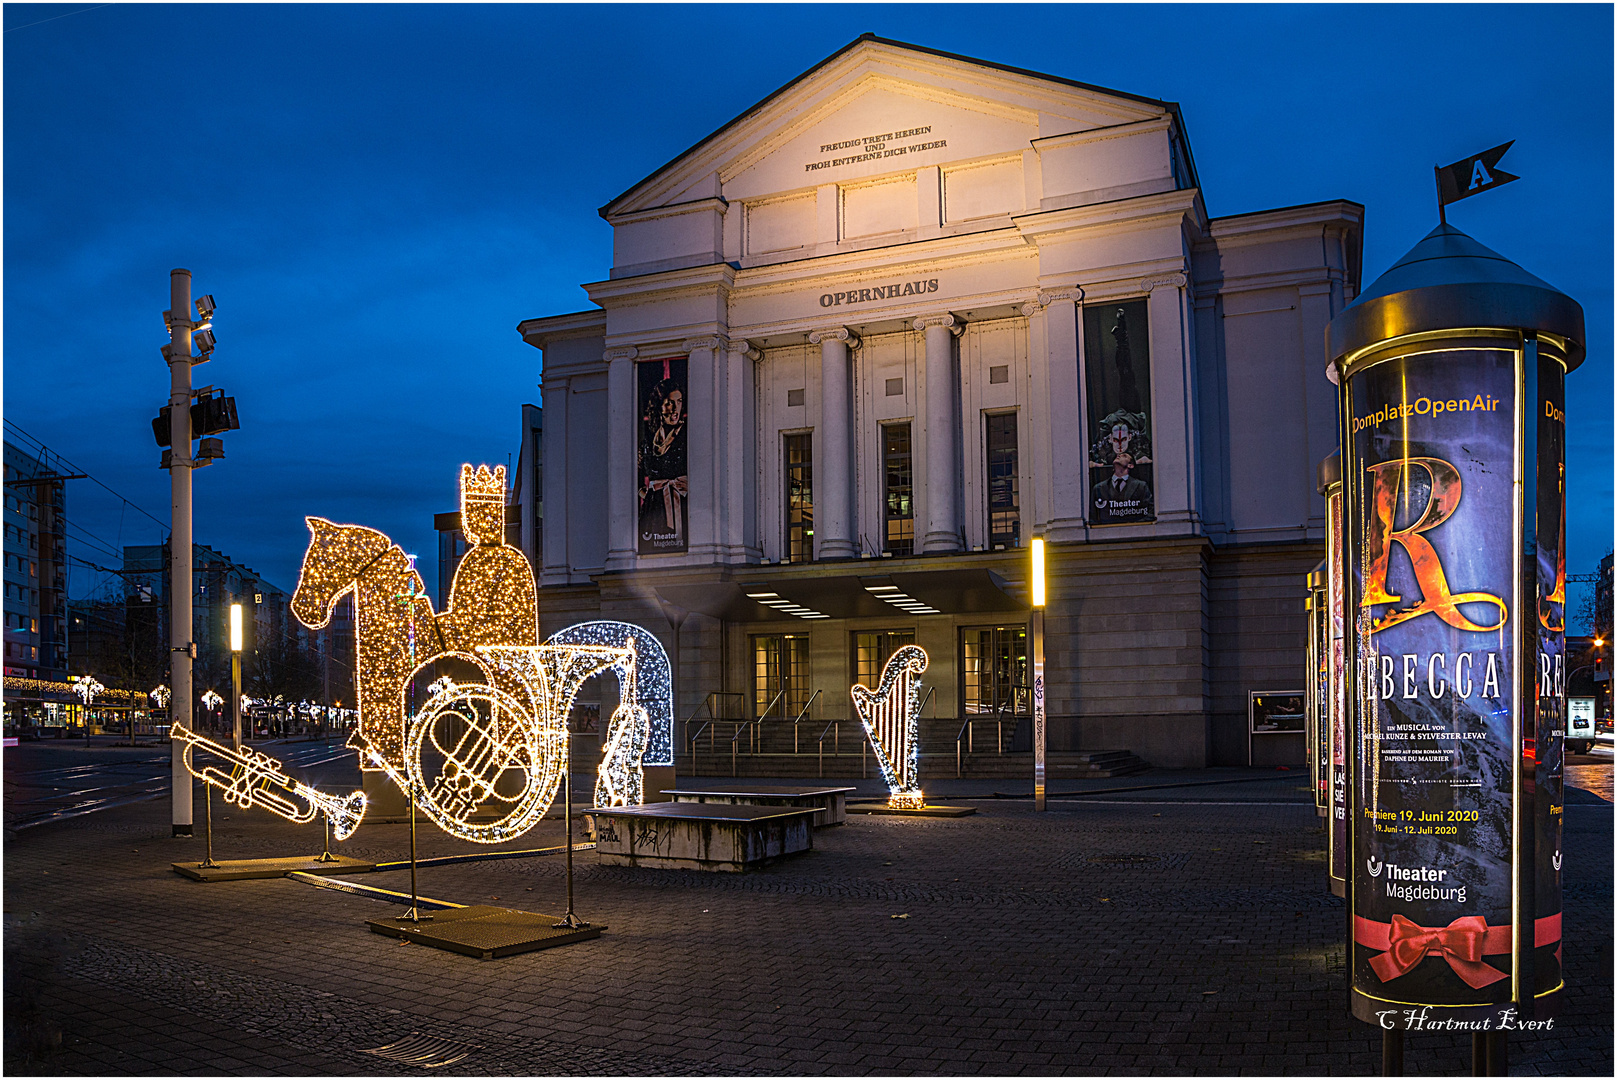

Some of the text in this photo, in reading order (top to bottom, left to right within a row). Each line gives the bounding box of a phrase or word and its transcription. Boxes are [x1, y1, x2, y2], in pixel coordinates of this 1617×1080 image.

[820, 126, 932, 153] FREUDIG TRETE HEREIN
[865, 143, 886, 153] UND
[805, 140, 947, 172] FROH ENTFERNE DICH WIEDER
[1468, 159, 1493, 190] A
[819, 278, 939, 308] OPERNHAUS
[1352, 394, 1500, 435] DomplatzOpenAir
[1110, 507, 1148, 517] Magdeburg
[1358, 456, 1508, 633] R
[1357, 652, 1500, 700] REBECCA
[1386, 732, 1409, 740] KUNZE
[1417, 732, 1461, 740] SYLVESTER
[1462, 732, 1487, 740] LEVAY
[1399, 810, 1416, 821] 19.
[1418, 810, 1444, 822] Juni
[1447, 810, 1479, 822] 2020
[1404, 826, 1416, 834] 12.
[1417, 826, 1433, 834] Juli
[1434, 826, 1457, 835] 2020
[1386, 864, 1447, 882] Theater
[1386, 882, 1467, 903] Magdeburg
